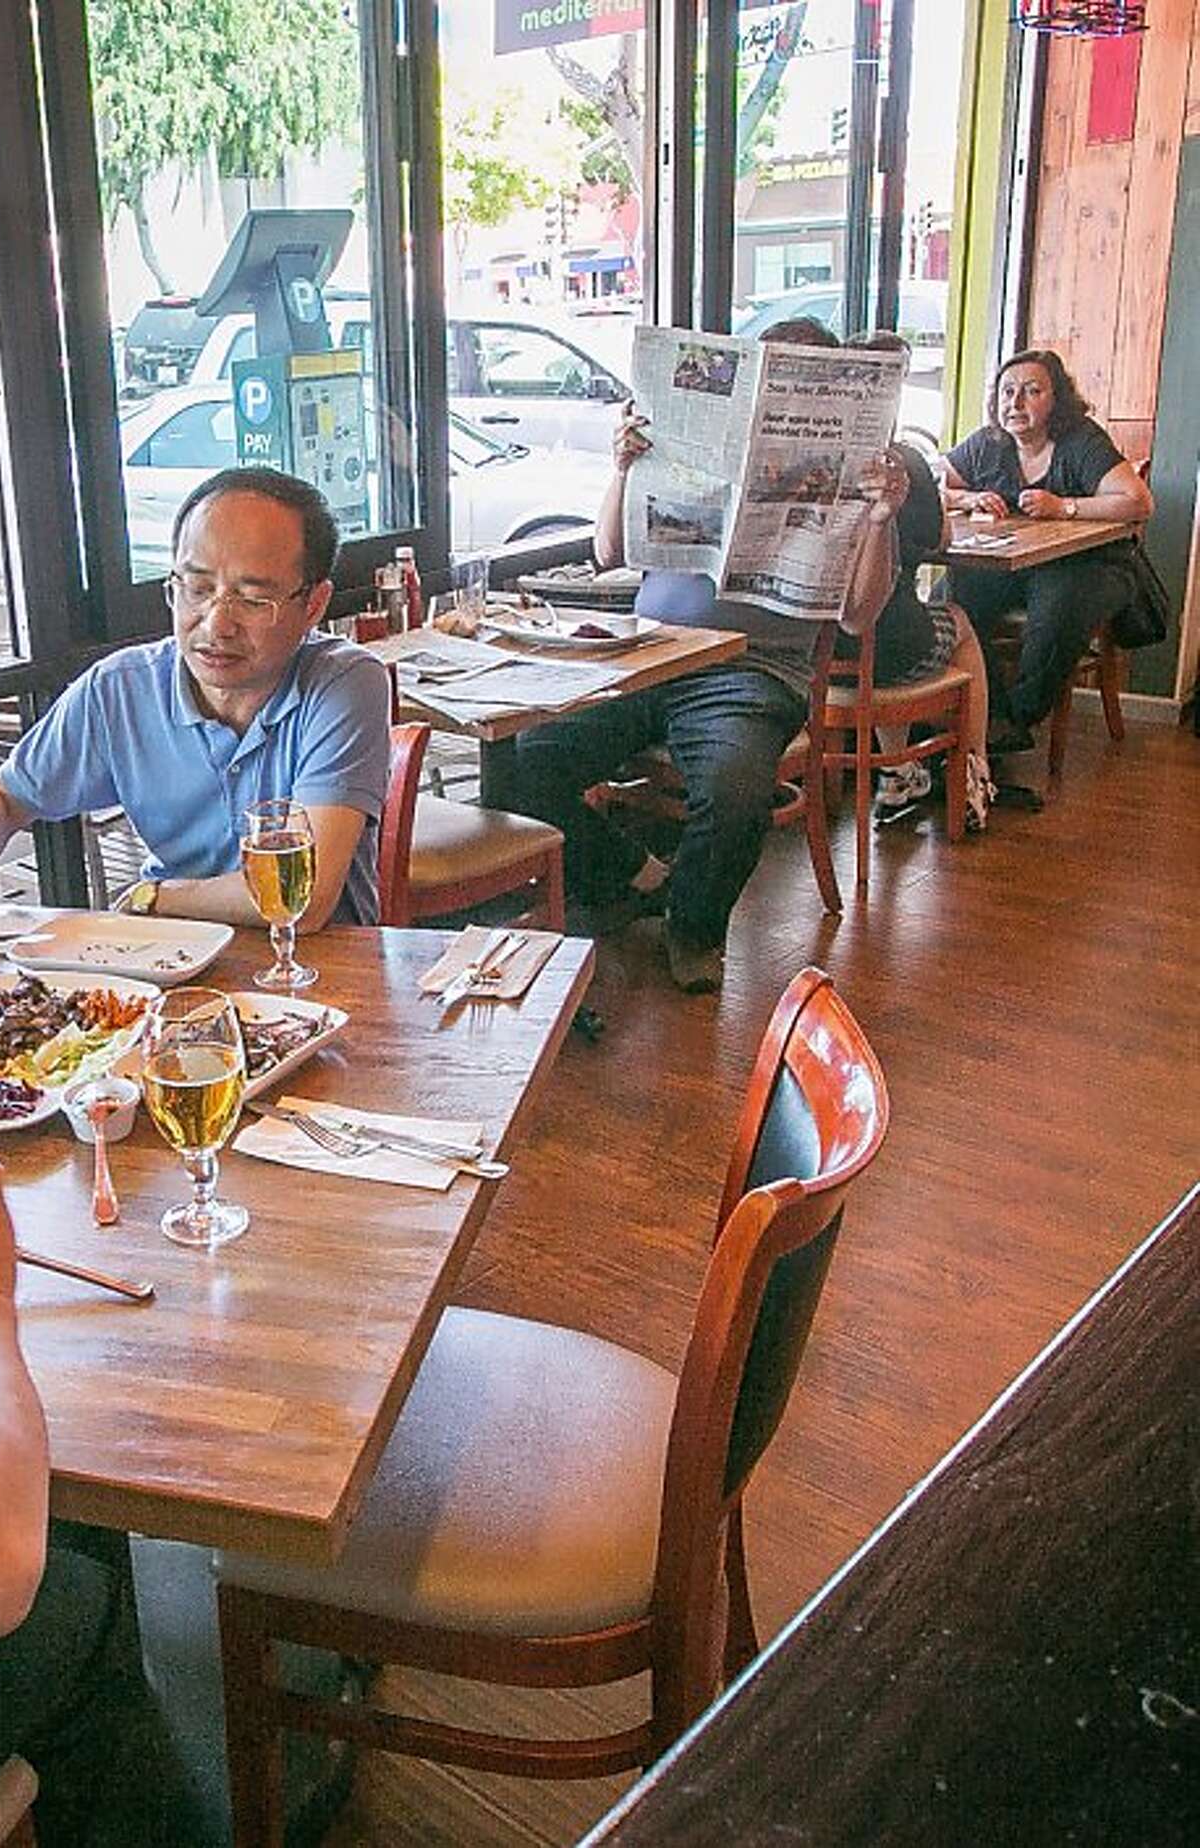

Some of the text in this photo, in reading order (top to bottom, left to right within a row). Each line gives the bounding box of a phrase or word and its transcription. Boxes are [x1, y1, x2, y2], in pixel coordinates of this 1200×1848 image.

[291, 282, 314, 318] P
[246, 381, 267, 418] P
[244, 433, 271, 454] PAY
